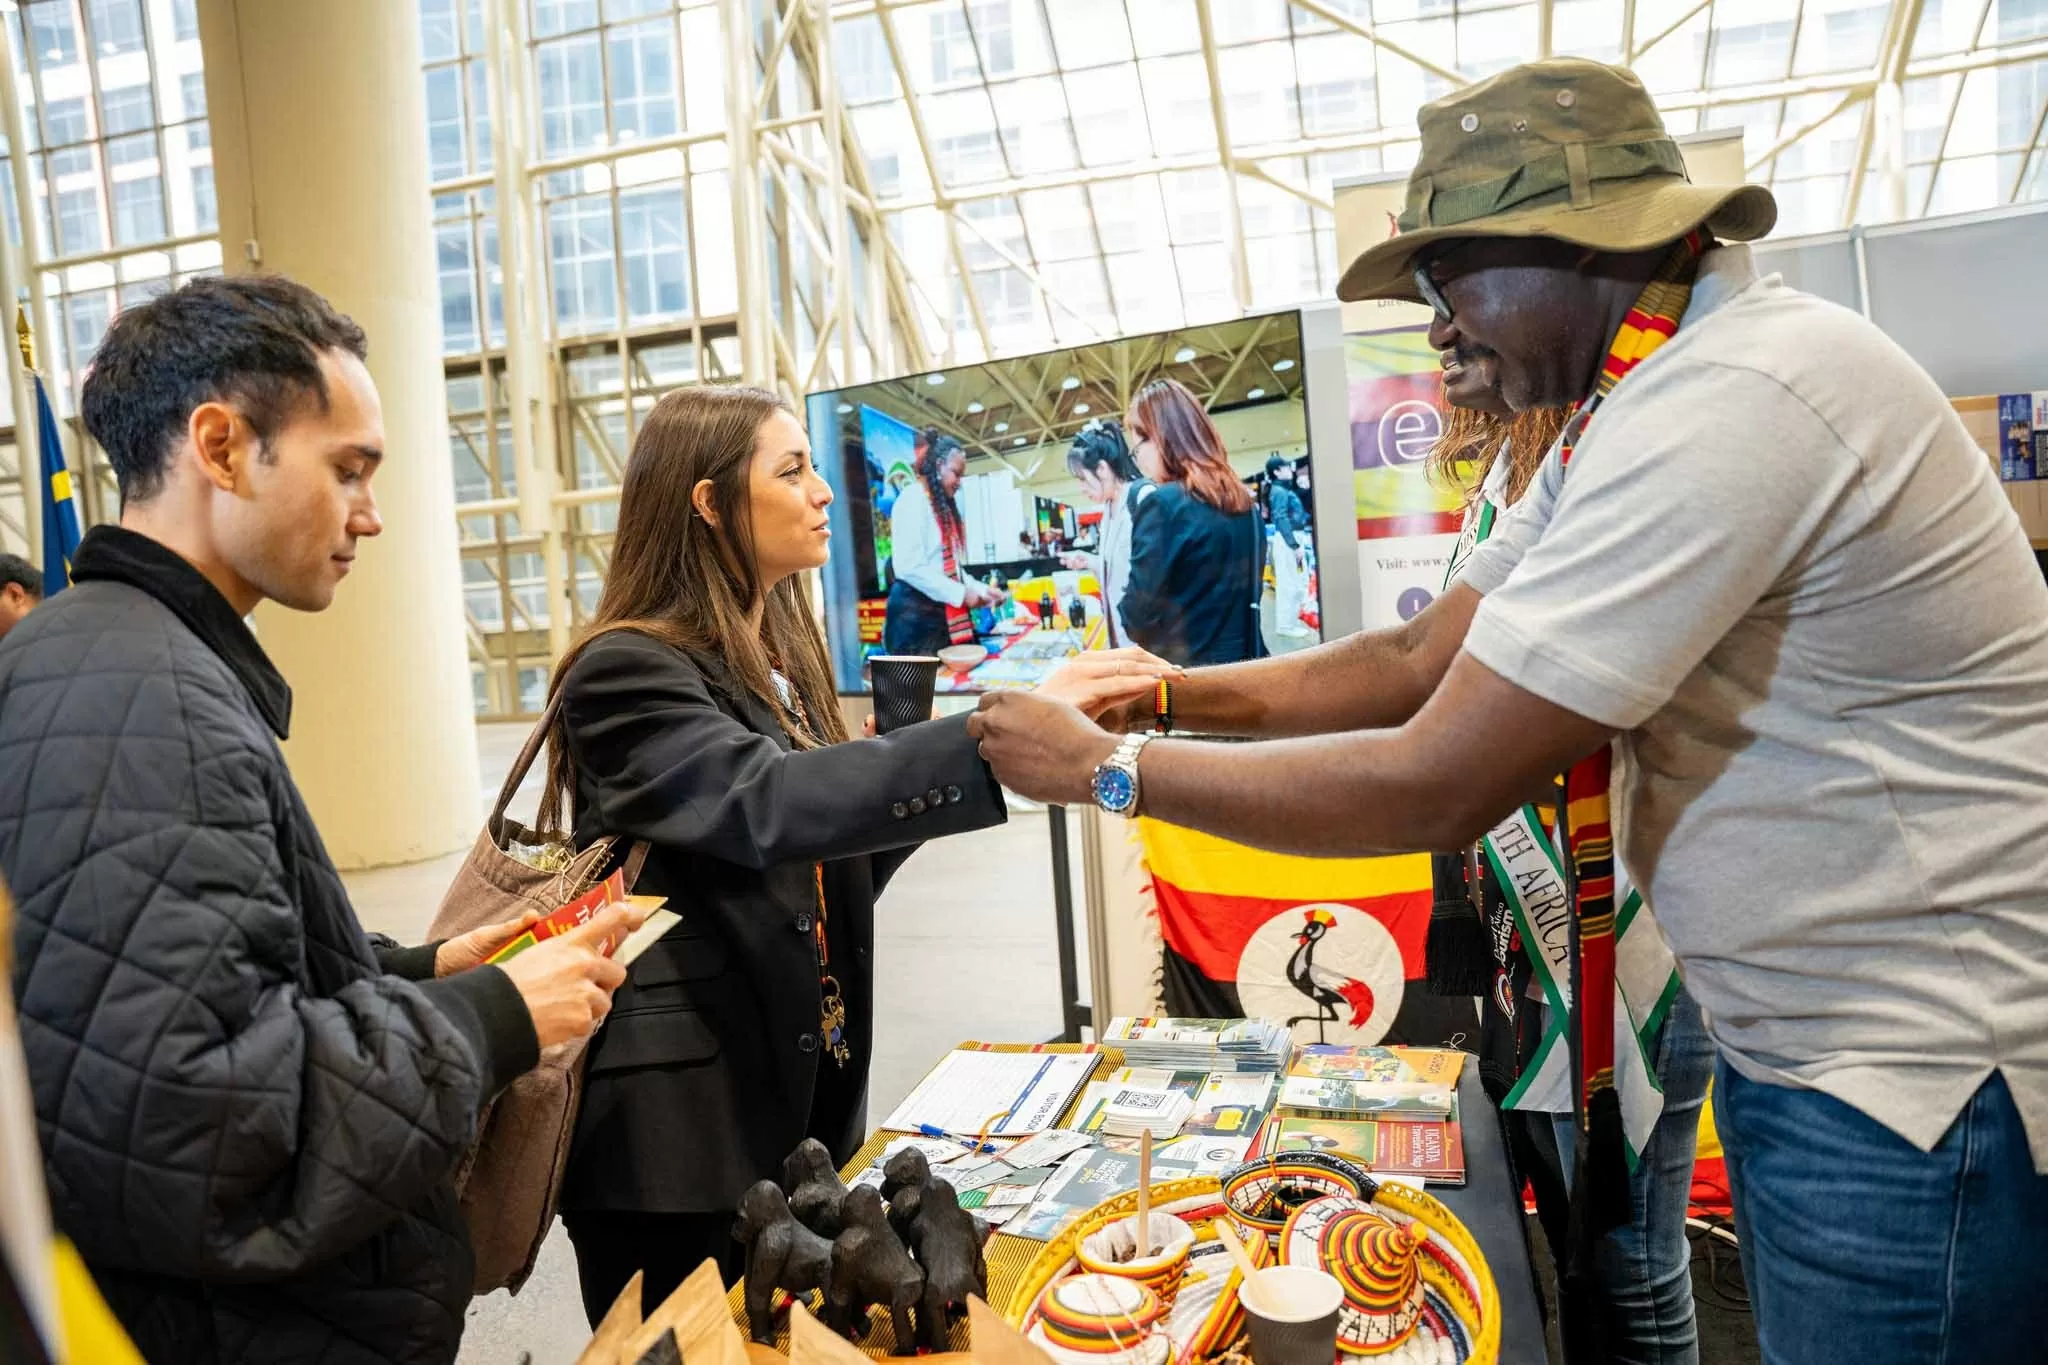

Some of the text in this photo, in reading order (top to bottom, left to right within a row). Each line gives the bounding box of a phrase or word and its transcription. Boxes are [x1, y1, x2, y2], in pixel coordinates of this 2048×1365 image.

[1376, 559, 1408, 569] Visit:
[1515, 868, 1569, 965] AFRICA
[1024, 1114, 1045, 1131] BOOK
[1424, 1128, 1441, 1163] UGANDA
